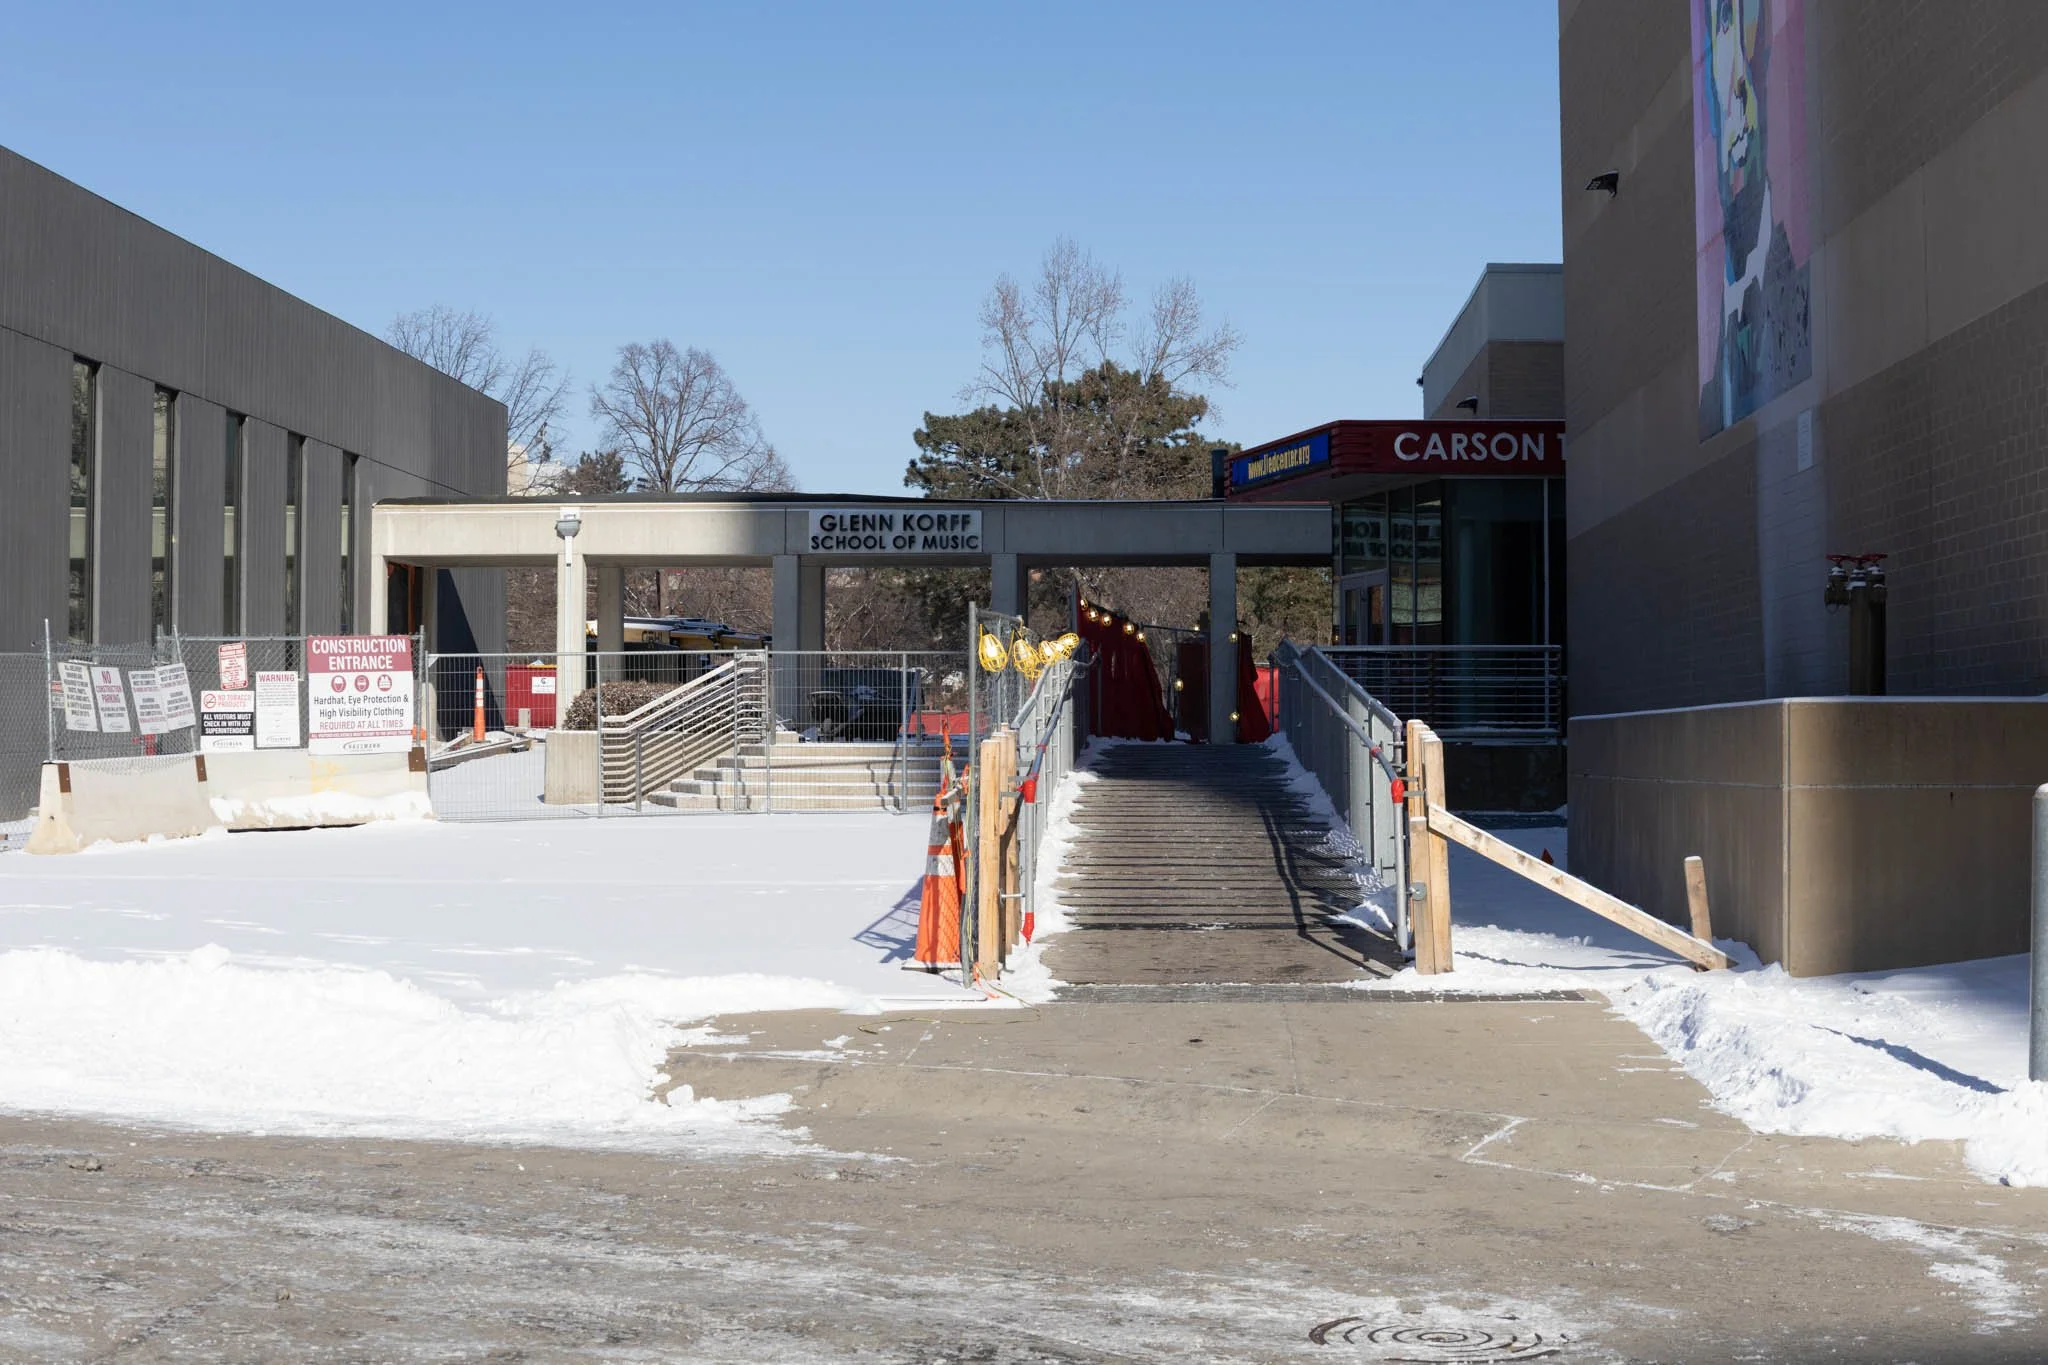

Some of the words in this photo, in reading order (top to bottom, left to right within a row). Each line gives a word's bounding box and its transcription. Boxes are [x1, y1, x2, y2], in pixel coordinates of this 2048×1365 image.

[1393, 432, 1545, 461] CARSON
[819, 514, 893, 532] GLENN
[903, 514, 972, 531] KORFF
[811, 535, 886, 550] SCHOOL
[892, 535, 916, 550] OF
[922, 535, 979, 550] MUSIC
[312, 639, 406, 654] CONSTRUCTION
[329, 655, 393, 670] ENTRANCE
[101, 671, 111, 684] NO
[259, 674, 294, 682] WARNING
[314, 696, 346, 705] Hardhat,
[348, 695, 361, 706] Eye
[363, 694, 401, 704] Protection
[403, 694, 409, 703] &
[203, 713, 213, 721] ALL
[213, 713, 236, 721] VISITORS
[237, 713, 252, 721] MUST
[320, 708, 336, 719] High
[339, 708, 371, 718] Visibility
[373, 706, 404, 717] Clothing
[203, 720, 220, 728] CHECK
[221, 720, 227, 728] IN
[228, 720, 241, 728] WITH
[320, 721, 355, 730] REQUIRED
[357, 720, 365, 729] AT
[367, 720, 380, 729] ALL
[382, 719, 403, 728] TIMES
[205, 727, 249, 735] SUPERINTENDENT
